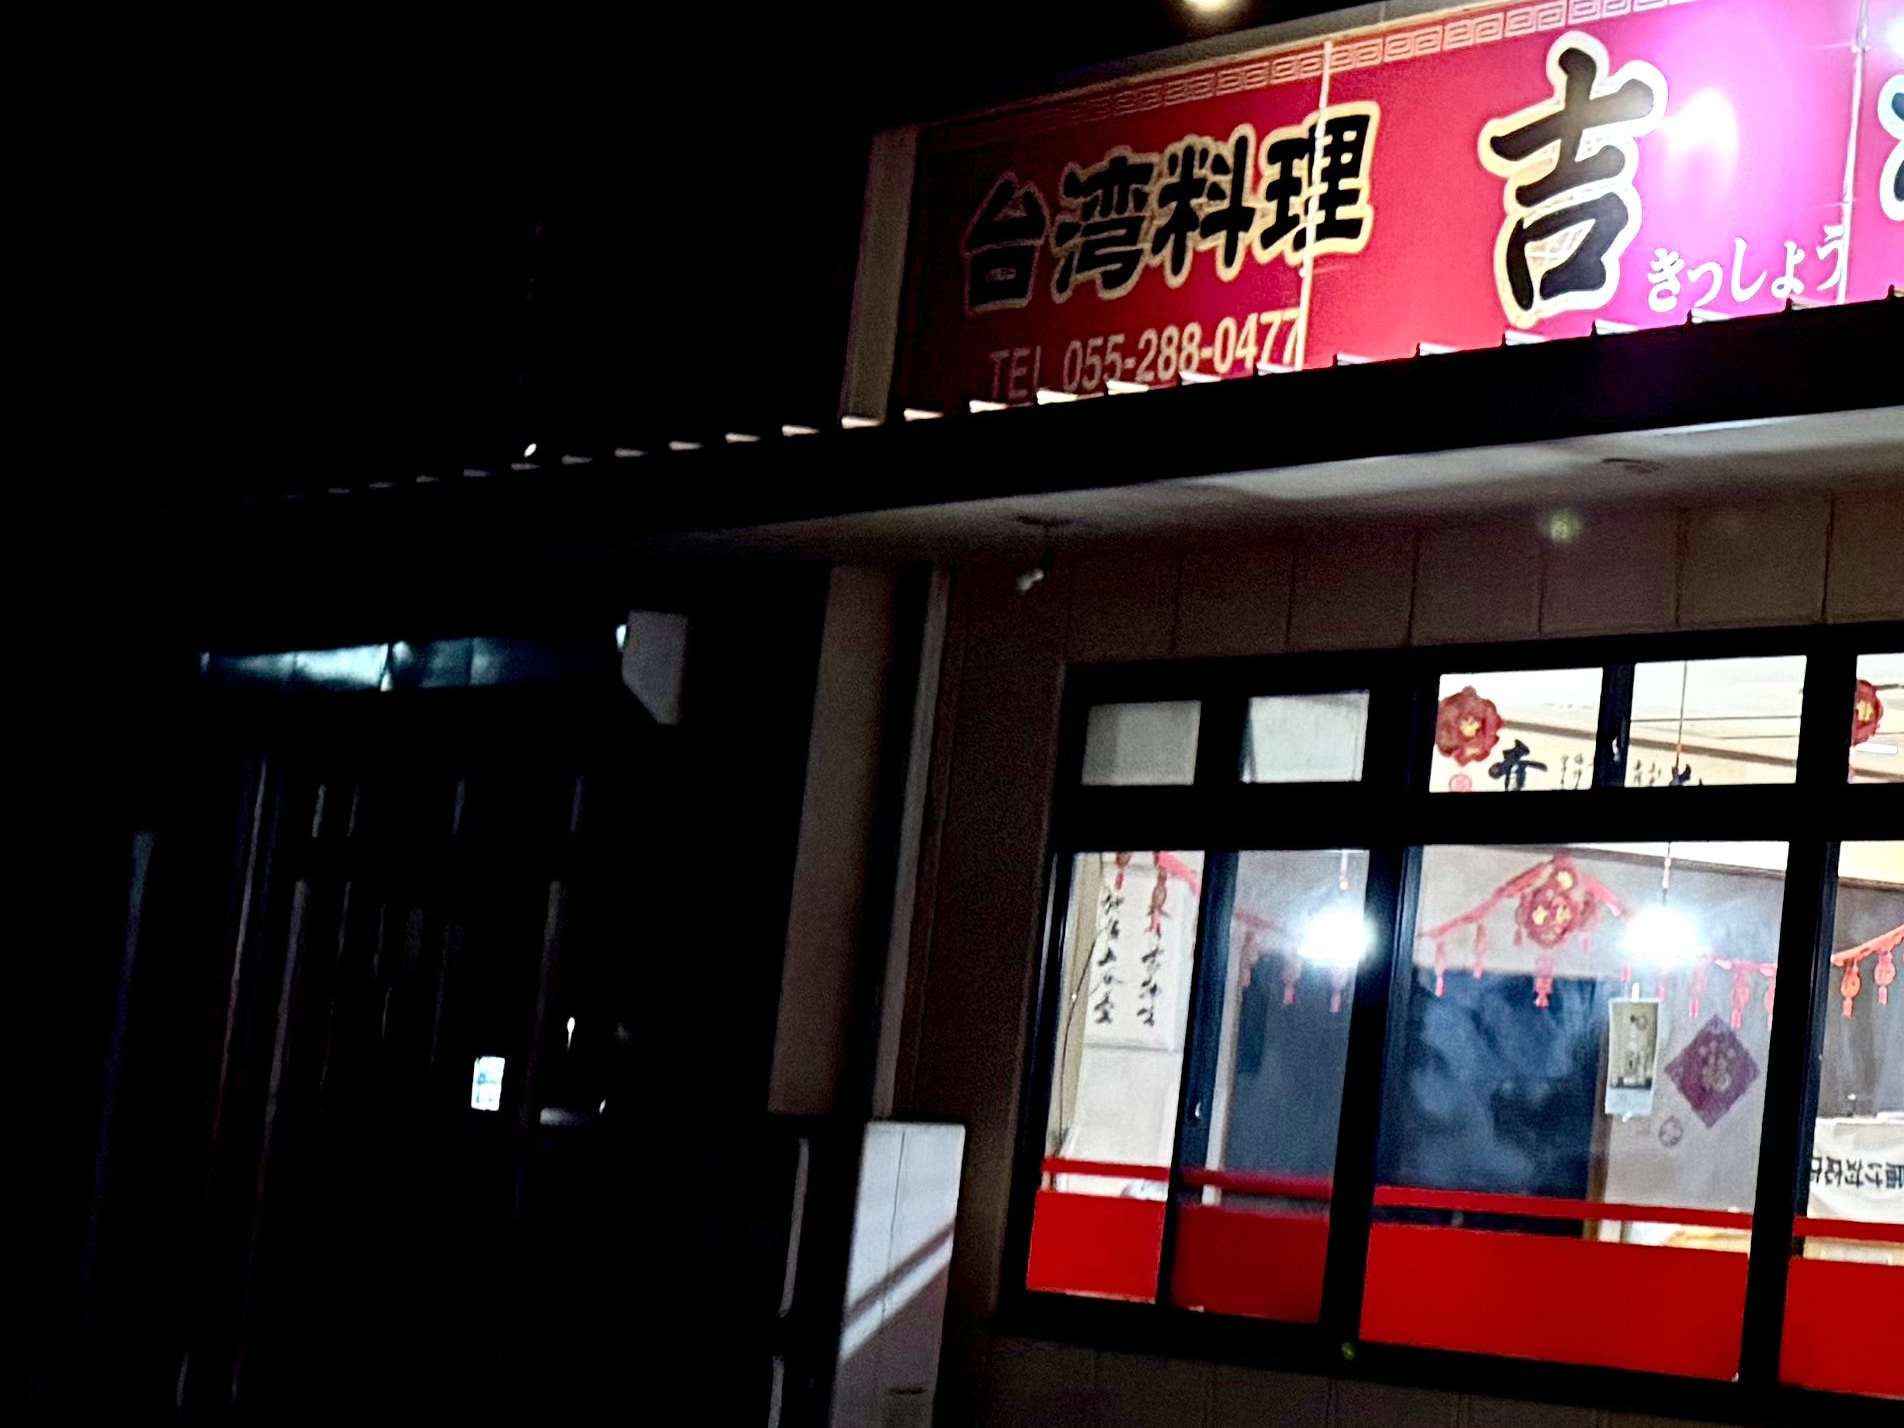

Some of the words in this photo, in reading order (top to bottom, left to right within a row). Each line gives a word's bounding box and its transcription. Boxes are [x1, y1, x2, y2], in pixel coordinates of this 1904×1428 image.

[963, 101, 1381, 316] 台湾料理
[1648, 223, 1846, 310] きっしょう
[1062, 307, 1303, 393] 055-288-0477
